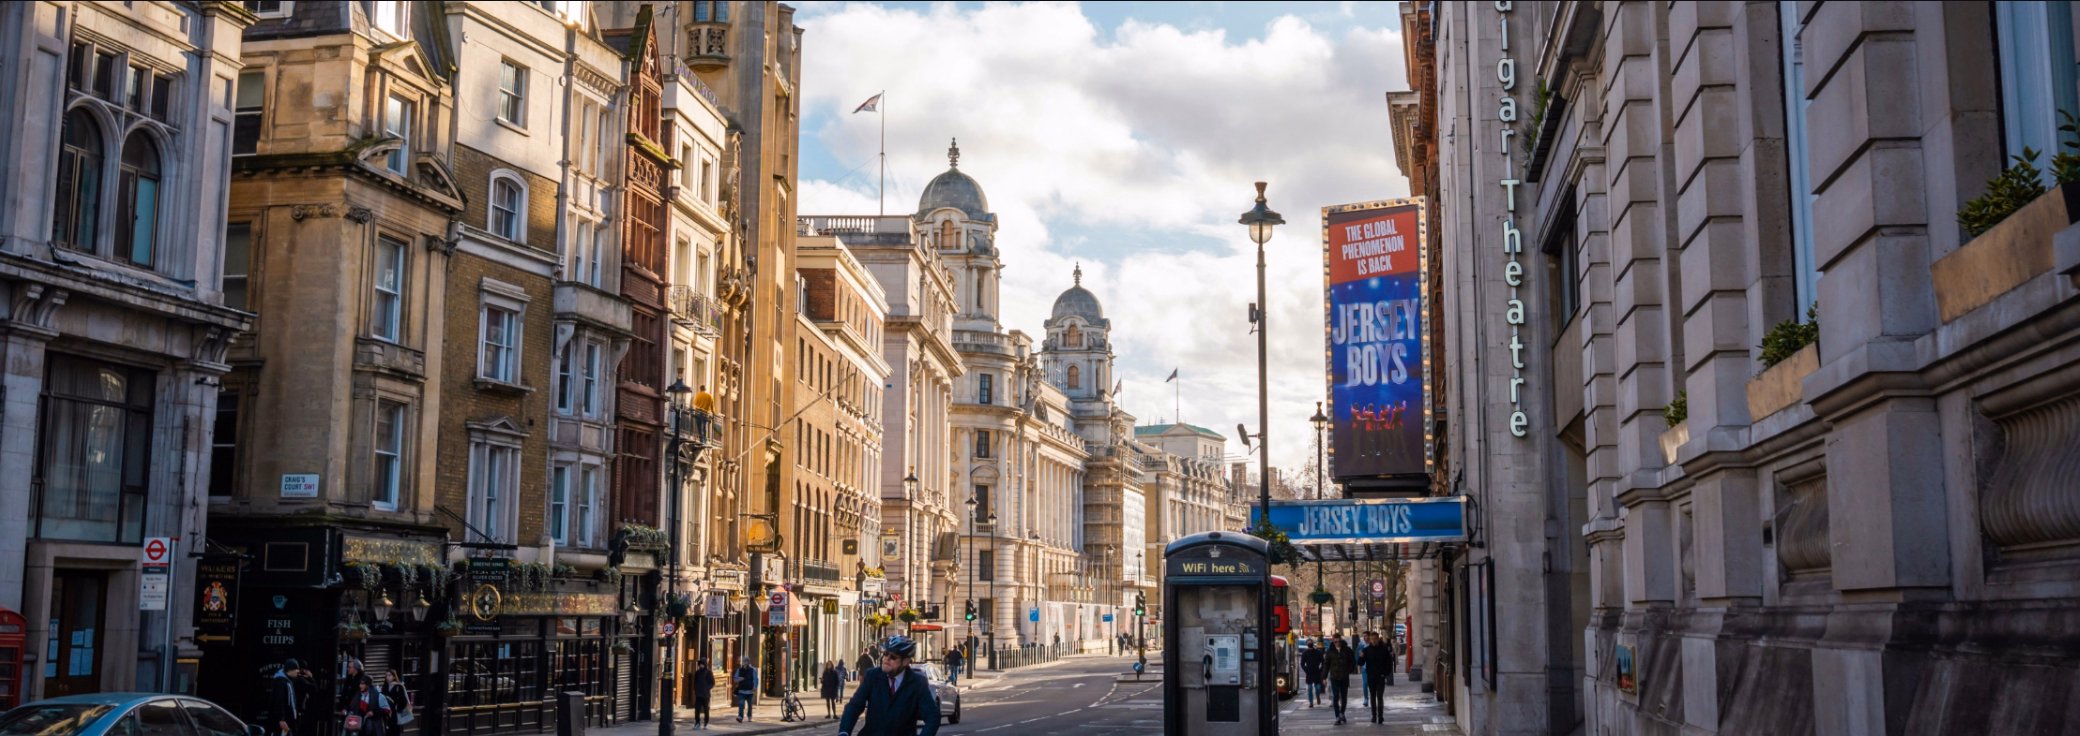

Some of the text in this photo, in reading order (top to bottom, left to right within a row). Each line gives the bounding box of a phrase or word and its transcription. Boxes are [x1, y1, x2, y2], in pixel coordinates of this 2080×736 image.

[1345, 218, 1398, 241] THE GLOBAL
[1342, 234, 1405, 261] PHENOMENON
[1357, 258, 1393, 275] IS BACK
[1500, 179, 1528, 438] Theatre
[1332, 298, 1418, 345] JERSEY
[1346, 343, 1407, 387] BOYS
[1299, 504, 1412, 536] JERSEY BOYS
[1182, 562, 1235, 572] WiFi here
[268, 620, 291, 628] FISH
[263, 636, 294, 644] CHIPS
